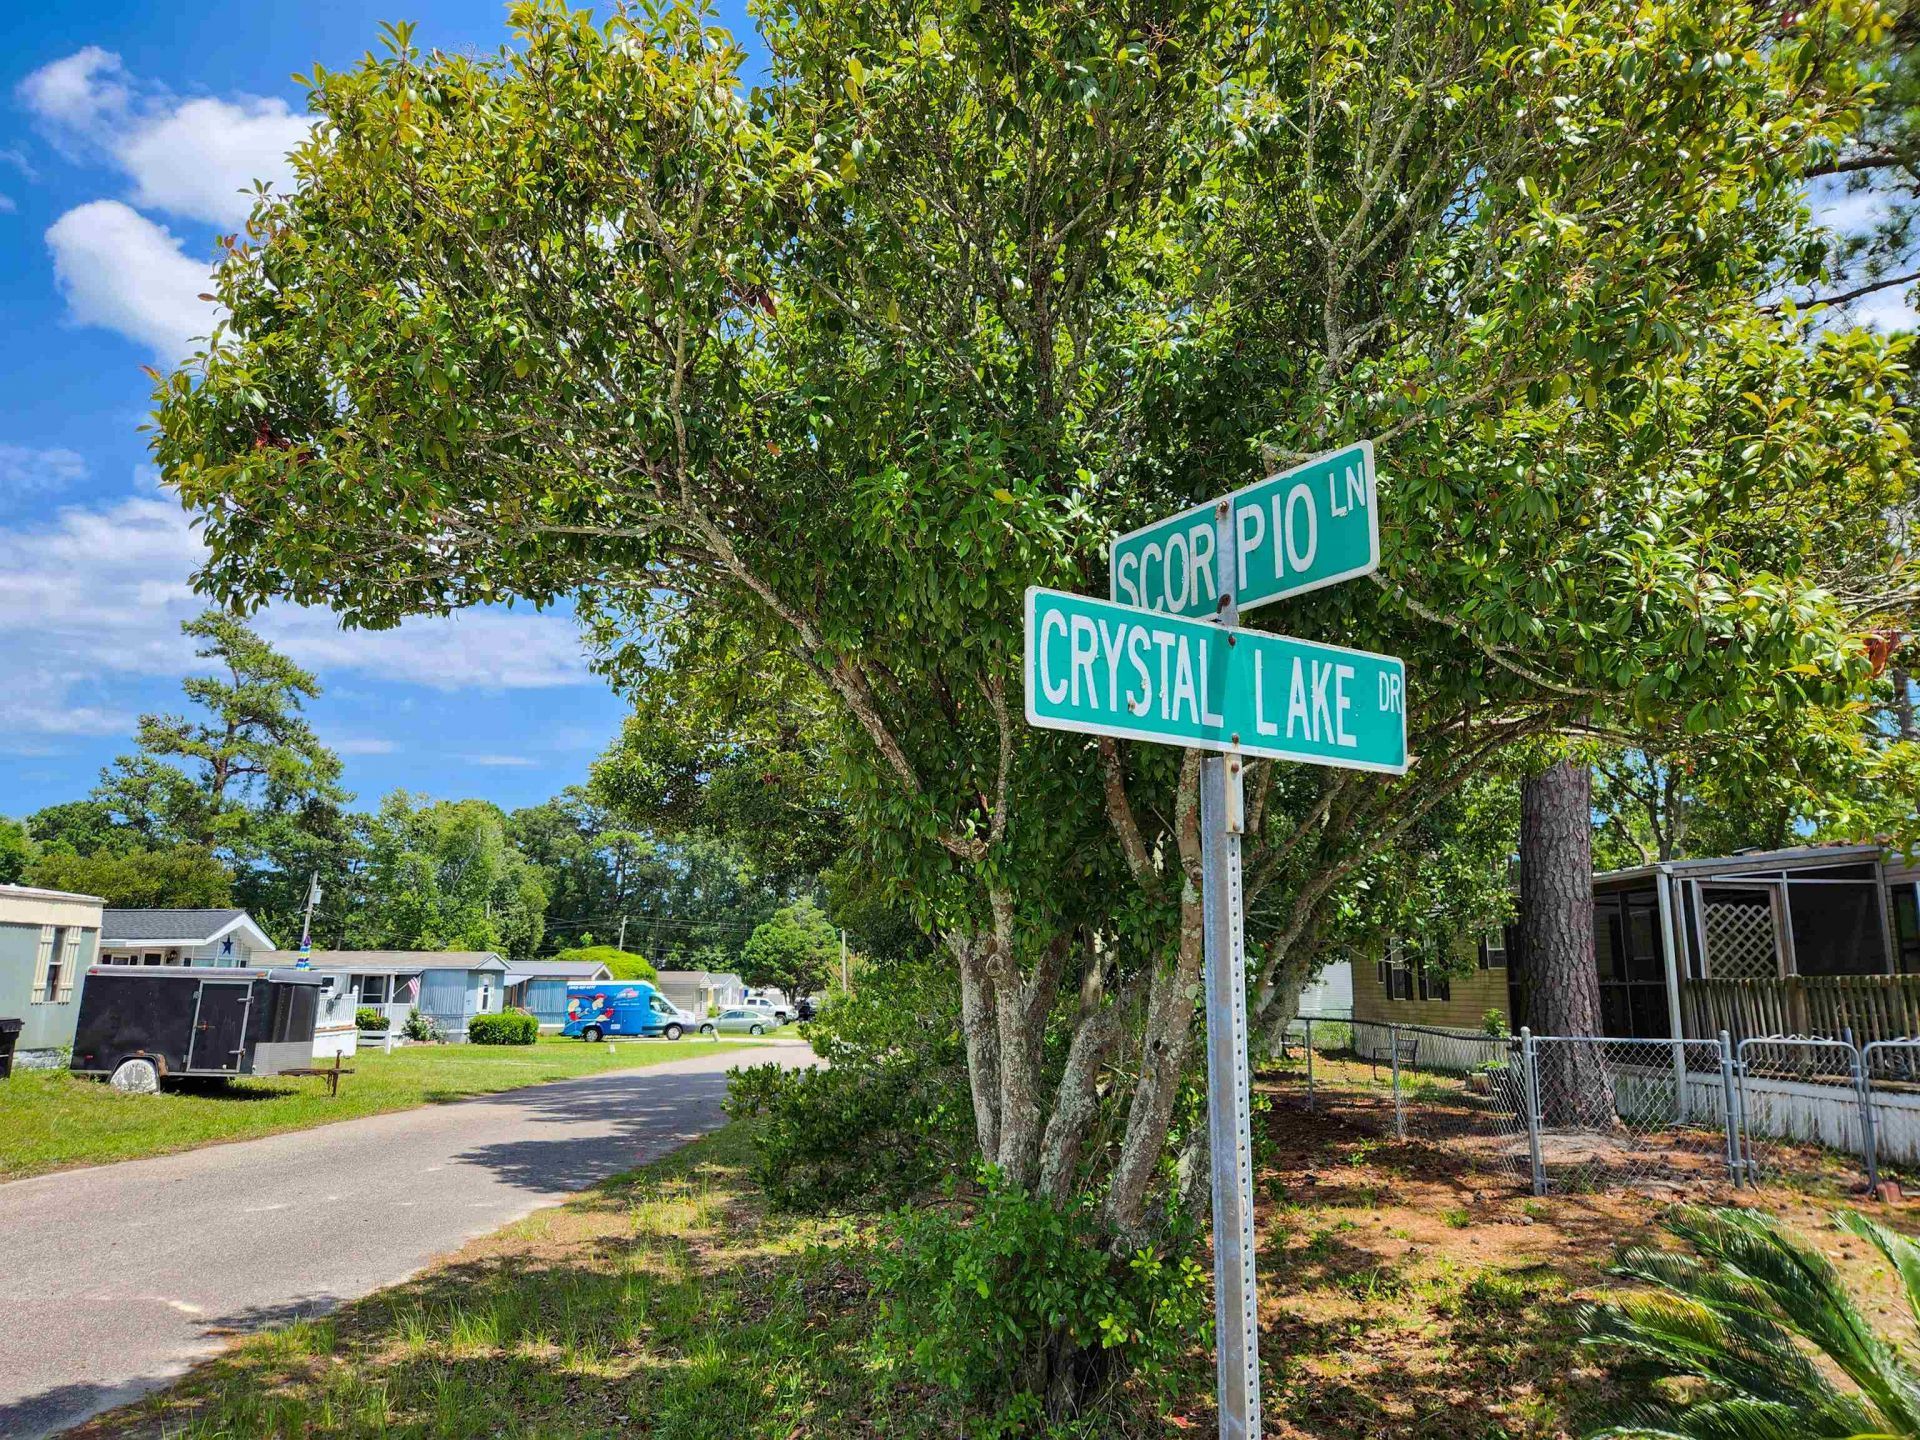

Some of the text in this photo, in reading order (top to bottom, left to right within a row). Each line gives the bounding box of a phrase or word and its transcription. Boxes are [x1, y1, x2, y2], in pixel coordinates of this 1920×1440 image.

[1118, 461, 1365, 612] SCORPIO LN
[1040, 608, 1402, 747] CRYSTAL LAKE DR
